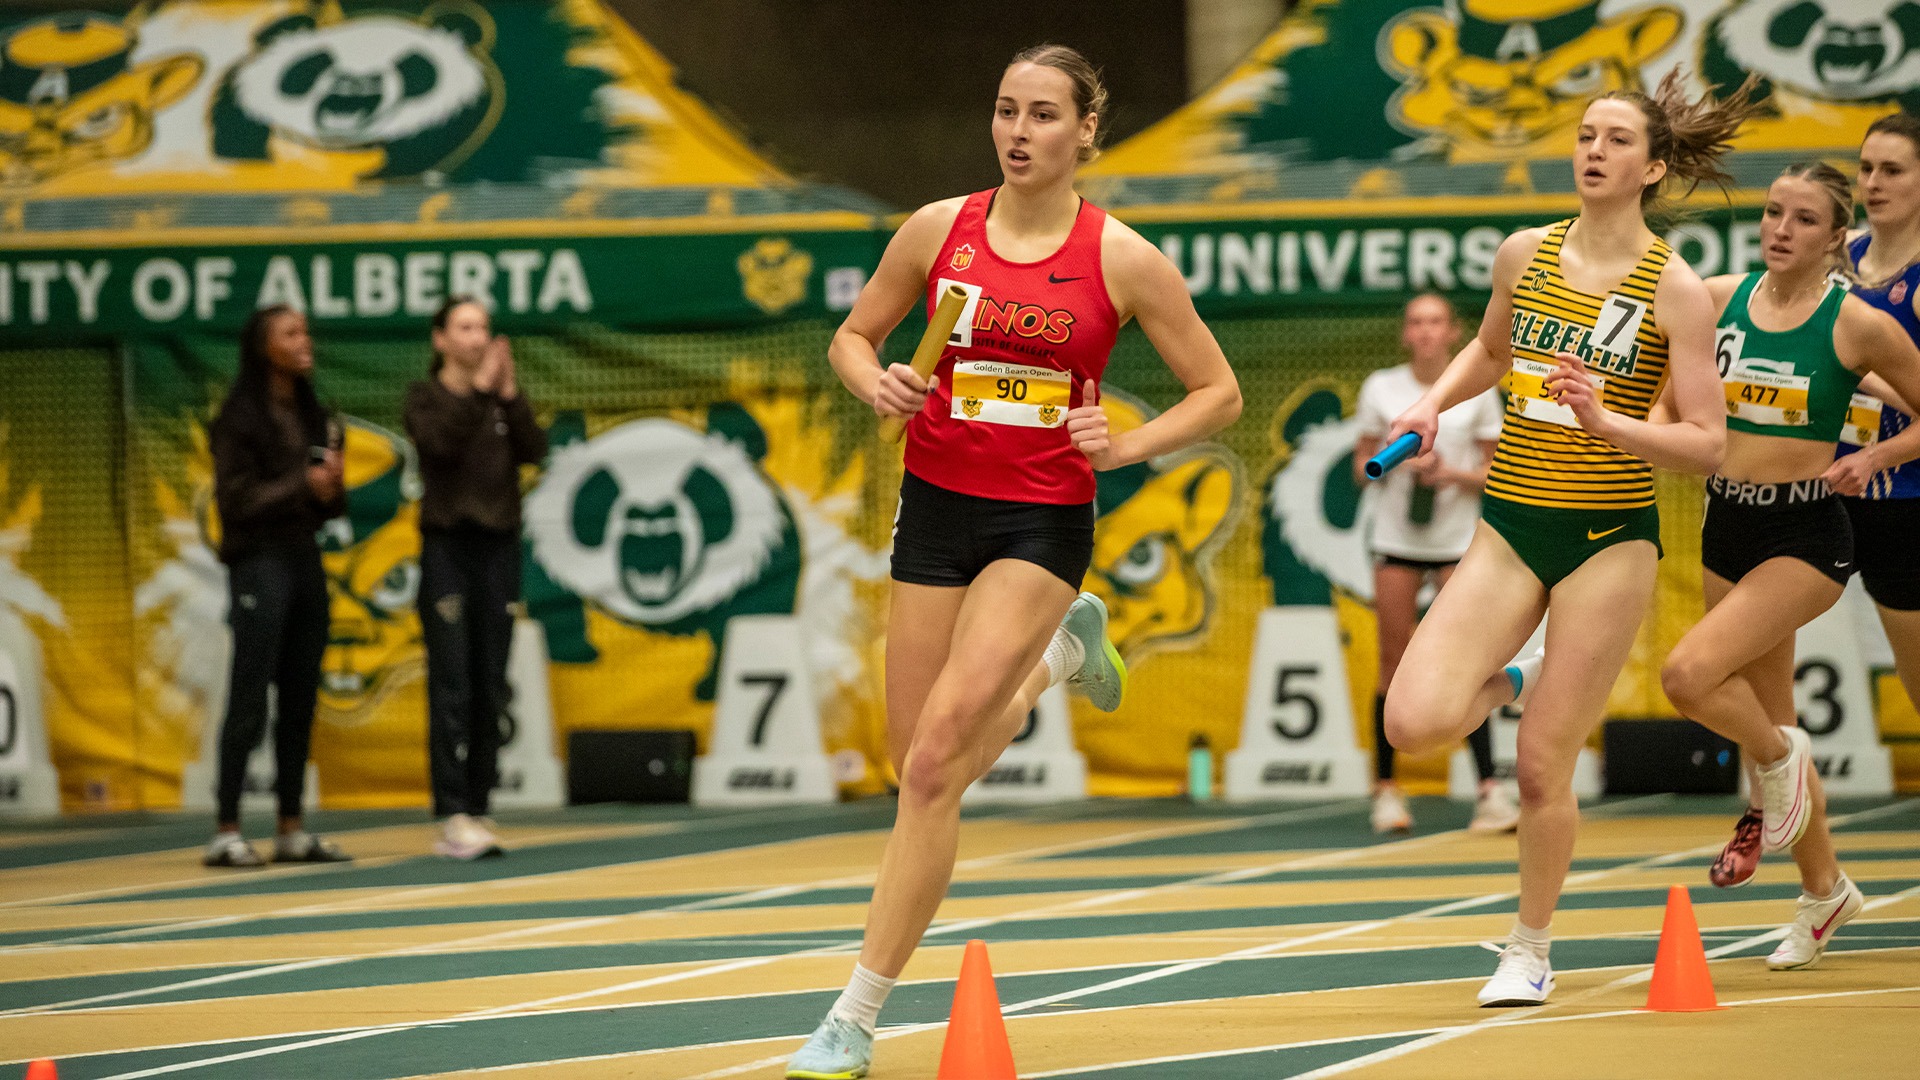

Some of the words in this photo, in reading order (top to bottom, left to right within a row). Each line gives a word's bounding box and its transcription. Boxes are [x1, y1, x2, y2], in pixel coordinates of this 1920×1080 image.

[1161, 228, 1498, 295] UNIVERS
[131, 257, 235, 321] OF
[256, 250, 592, 318] ALBERTA
[972, 297, 1076, 344] INOS
[1601, 299, 1638, 346] 7
[973, 363, 1003, 374] Golden
[1005, 366, 1028, 376] Bears
[1030, 368, 1053, 379] Open
[999, 340, 1011, 350] OF
[1014, 343, 1056, 358] CALGARY
[1716, 333, 1736, 379] 6
[996, 378, 1028, 401] 90
[1741, 384, 1779, 405] 477
[1724, 480, 1777, 506] PRO
[1788, 478, 1835, 504] NIK
[740, 673, 790, 746] 7
[1273, 663, 1321, 741] 5
[1794, 659, 1843, 736] 3
